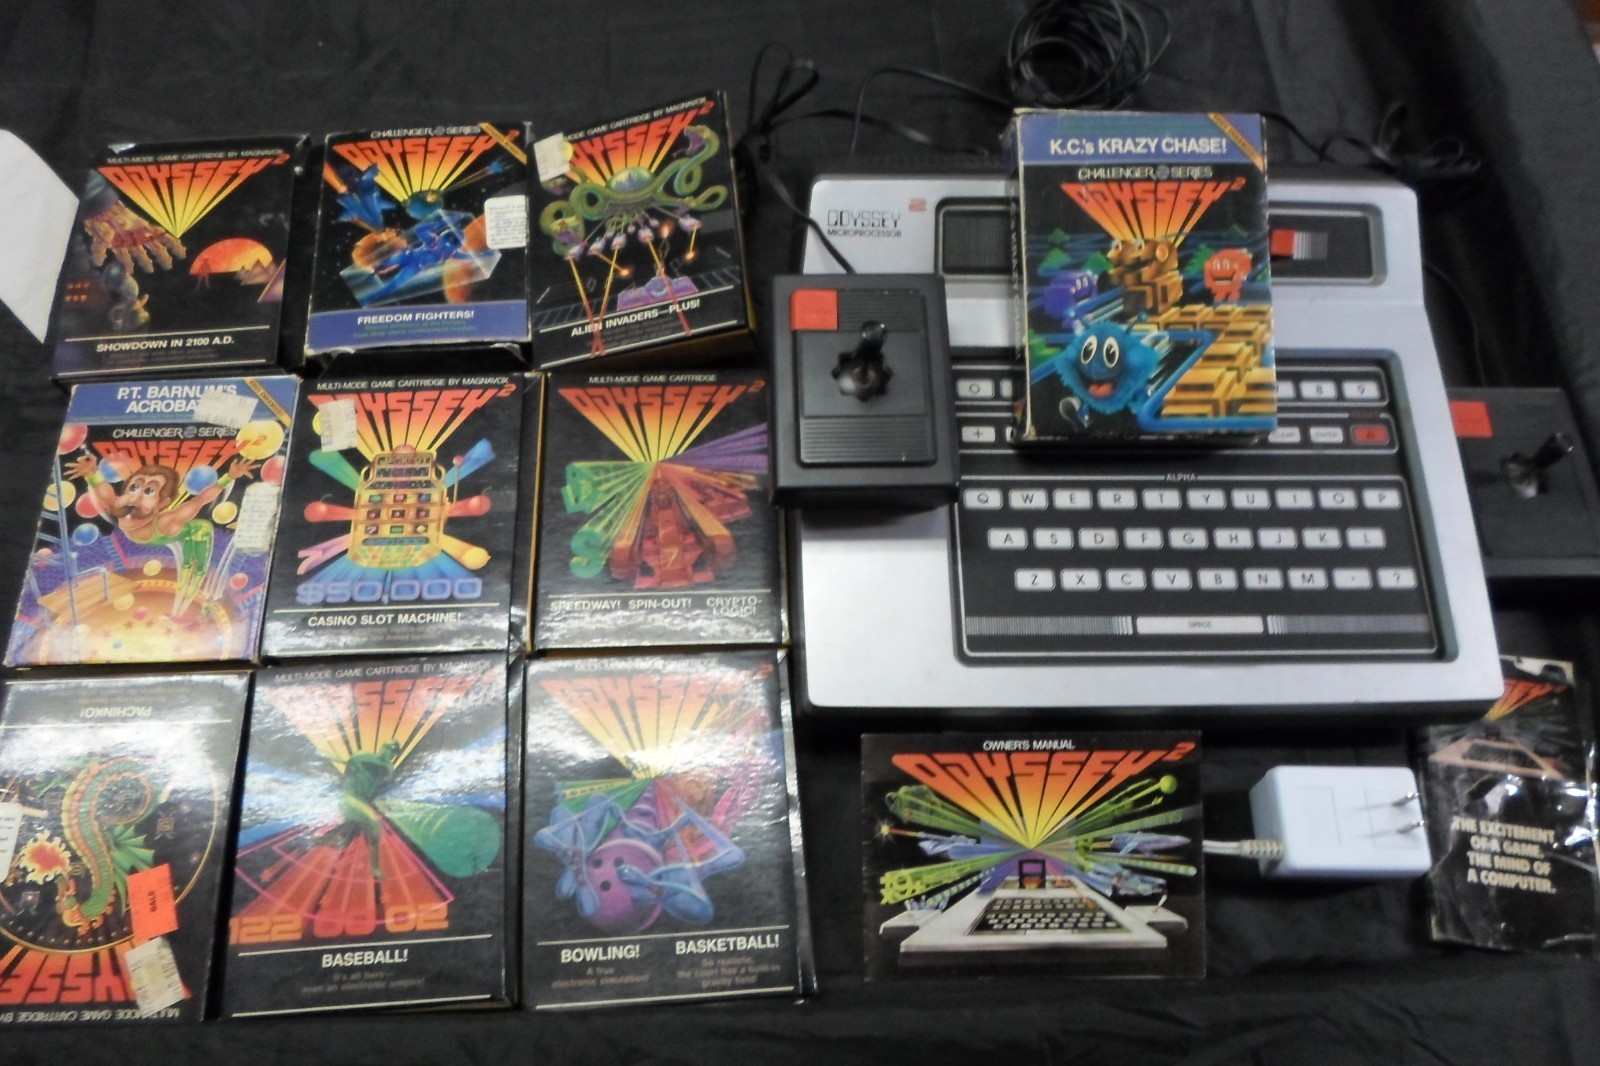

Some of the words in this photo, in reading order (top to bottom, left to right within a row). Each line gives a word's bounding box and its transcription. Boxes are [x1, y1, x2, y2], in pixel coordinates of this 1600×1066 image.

[586, 122, 608, 137] GAME
[610, 113, 652, 130] CARTRIDGE
[653, 108, 666, 119] BY
[370, 127, 434, 140] CHALLENGER
[445, 125, 481, 136] SERIES
[1050, 137, 1095, 156] K.C.'s
[1098, 137, 1159, 155] KRAZY
[1161, 136, 1227, 155] CHASE!
[106, 155, 154, 165] MULTI-MODE
[156, 153, 179, 162] GAME
[181, 151, 226, 161] CARTRIDGE
[227, 150, 238, 159] BY
[1078, 166, 1157, 181] CHALLENGER
[1170, 165, 1213, 181] SERIES
[827, 209, 902, 229] ODYSSEY
[827, 229, 903, 239] MICROPROCESSOR
[357, 313, 413, 326] FREEDOM
[415, 310, 475, 322] FIGHTERS!
[571, 321, 603, 338] ALIEN
[96, 340, 168, 353] SHOWDOWN
[170, 338, 183, 348] IN
[185, 337, 210, 347] 2100
[212, 335, 236, 346] A.D.
[316, 381, 368, 391] MULTI-MODE
[370, 379, 396, 389] GAME
[397, 378, 445, 388] CARTRIDGE
[448, 377, 460, 386] BY
[462, 376, 509, 386] MAGNAVOX
[588, 376, 640, 385] MULTI-MODE
[642, 375, 667, 384] GAME
[669, 373, 718, 383] CARTRIDGE
[117, 385, 143, 400] P.T.
[112, 427, 184, 440] CHALLENGER
[197, 426, 239, 439] SERIES
[1165, 473, 1198, 483] ALPHA
[977, 493, 989, 504] Q
[1022, 494, 1034, 504] W
[1070, 494, 1076, 504] E
[1114, 494, 1122, 504] R
[1158, 494, 1165, 504] T
[1202, 494, 1211, 504] Y
[1246, 494, 1256, 504] U
[1332, 492, 1344, 504] O
[1378, 494, 1386, 504] P
[1003, 533, 1014, 544] A
[1050, 533, 1058, 544] S
[1094, 533, 1104, 544] D
[1141, 533, 1148, 544] F
[1183, 533, 1195, 544] G
[1230, 534, 1238, 544] H
[1318, 533, 1328, 544] K
[1364, 534, 1370, 544] L
[1030, 574, 1039, 586] Z
[1076, 574, 1085, 586] X
[1120, 574, 1132, 585] C
[1166, 574, 1177, 584] V
[1214, 574, 1222, 585] B
[1258, 574, 1268, 585] N
[1302, 573, 1314, 585] M
[550, 599, 622, 613] SPEEDWAY!
[628, 597, 693, 611] SPIN-OUT!
[706, 595, 764, 607] CRYPTO-
[307, 614, 357, 628] CASINO
[360, 613, 395, 626] SLOT
[397, 611, 462, 625] MACHINE!
[275, 670, 333, 683] MULTI-MODE
[335, 667, 363, 678] GAME
[365, 664, 420, 677] CARTRIDGE
[422, 663, 438, 673] BY
[79, 705, 153, 719] PACHINKO!
[1033, 739, 1076, 750] MANUAL
[1451, 815, 1478, 833] THE
[1479, 820, 1556, 844] EXCITEMENT
[1470, 834, 1489, 850] OF
[1491, 838, 1501, 853] A
[1467, 850, 1493, 869] THE
[1493, 854, 1531, 873] MIND
[1533, 860, 1552, 876] OF
[1467, 867, 1479, 883] A
[1480, 869, 1557, 894] COMPUTER.
[560, 943, 641, 964] BOWLING!
[675, 933, 780, 956] BASKETBALL!
[321, 948, 409, 969] BASEBALL!
[17, 1011, 78, 1023] CARTRIDGE
[80, 1009, 113, 1021] GAME
